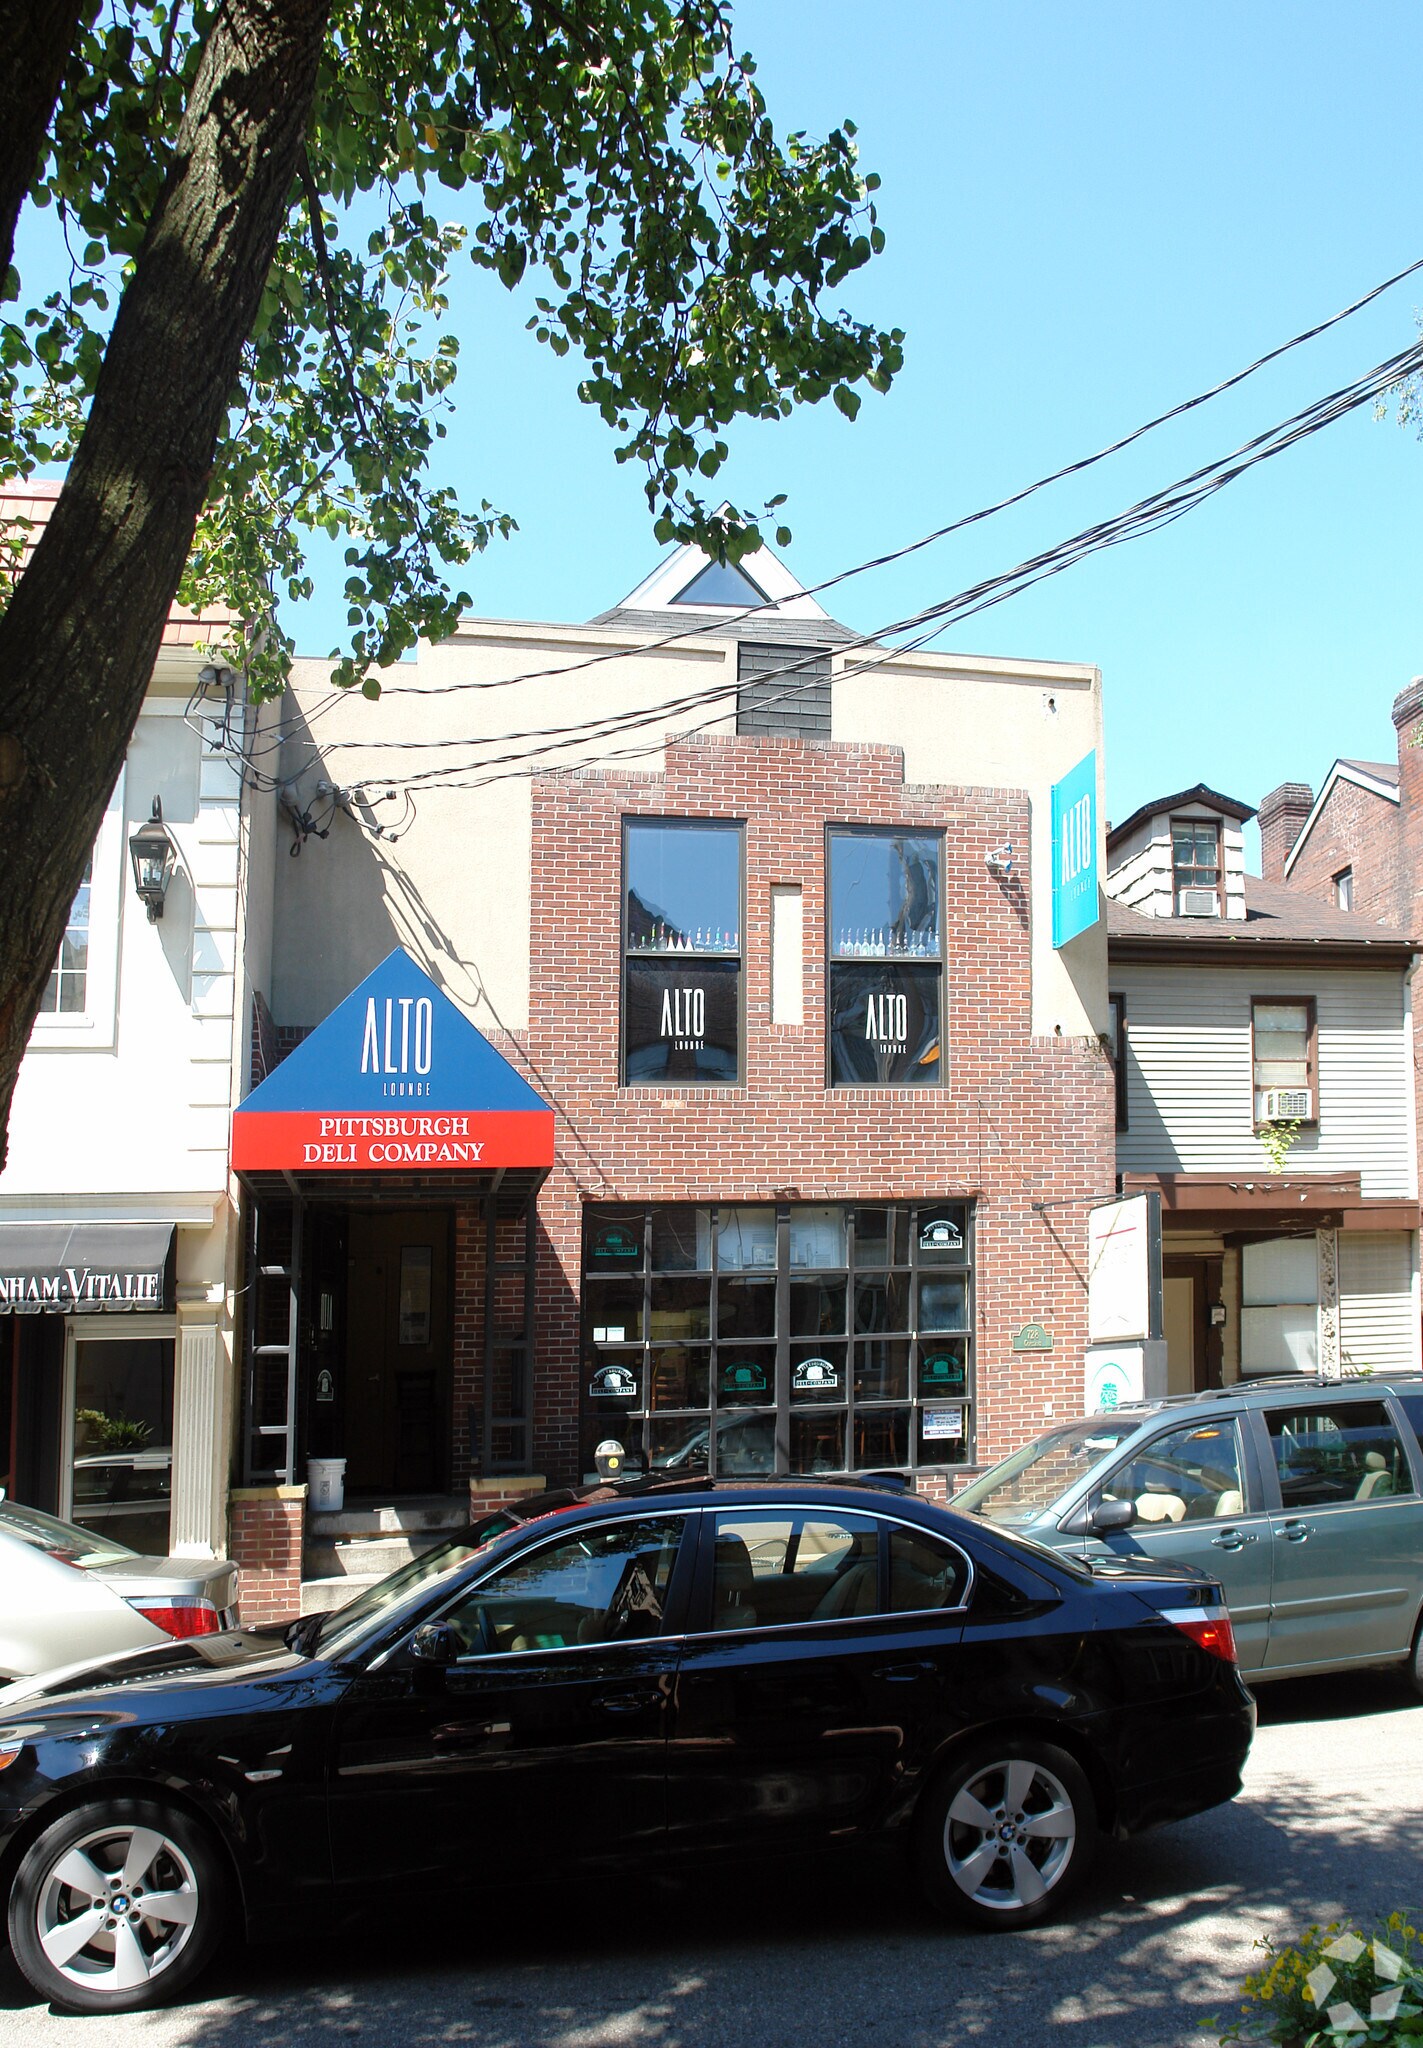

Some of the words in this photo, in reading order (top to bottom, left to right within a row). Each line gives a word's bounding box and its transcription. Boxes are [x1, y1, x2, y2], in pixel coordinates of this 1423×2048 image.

[1061, 793, 1091, 887] ALTO
[660, 988, 705, 1037] ALTO
[865, 994, 907, 1042] ALTO
[360, 997, 433, 1075] ALTO
[383, 1082, 431, 1097] LOUNGE
[319, 1117, 470, 1137] PITTSBURGH
[303, 1143, 357, 1163] DELI
[368, 1142, 485, 1162] COMPANY
[1026, 1329, 1039, 1340] 728
